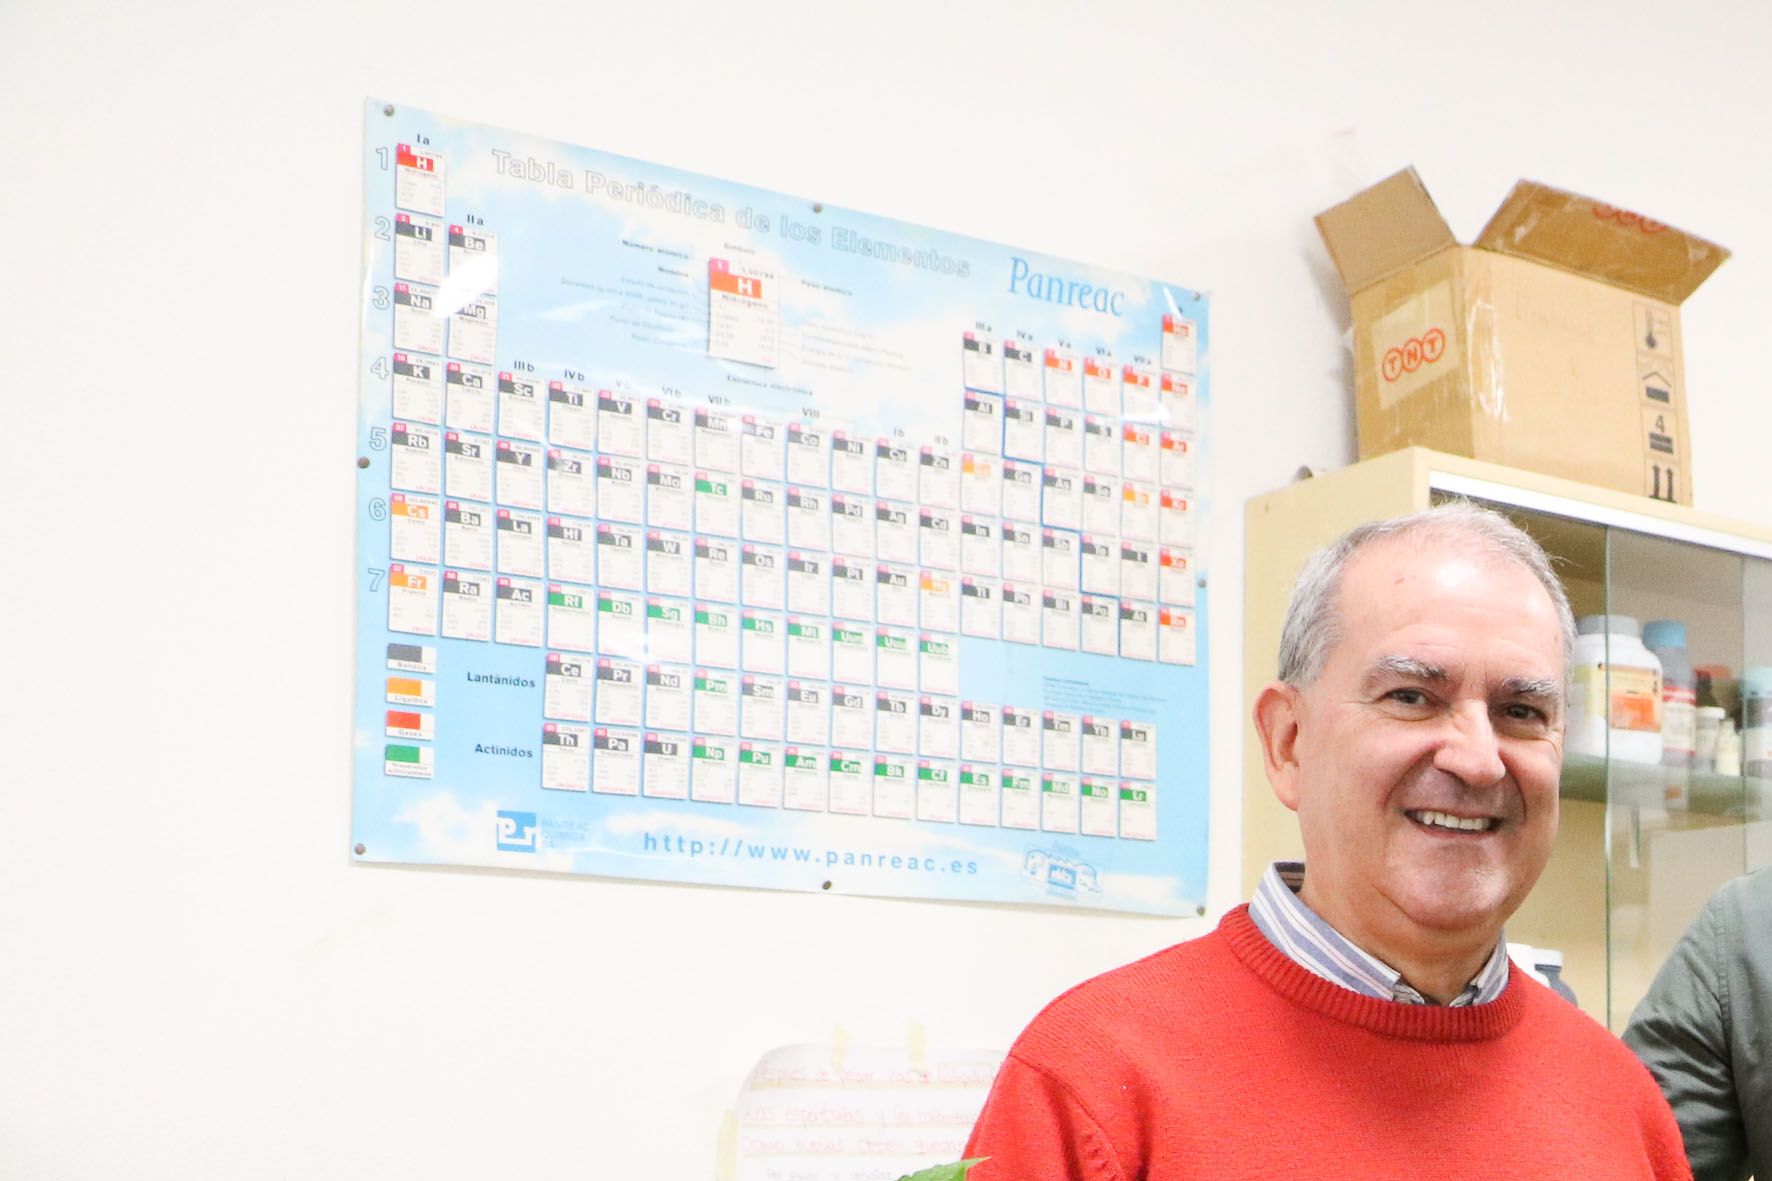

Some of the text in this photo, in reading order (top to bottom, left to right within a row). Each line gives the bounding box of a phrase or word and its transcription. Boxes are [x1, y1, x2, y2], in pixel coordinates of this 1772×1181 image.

[375, 147, 389, 171] 1
[416, 157, 427, 170] H
[491, 149, 971, 278] Tabla Periódica de los Elementos
[375, 216, 391, 241] 2
[414, 226, 427, 240] Li
[737, 277, 753, 294] H
[1008, 256, 1126, 317] Panreac
[372, 286, 390, 310] 3
[410, 295, 430, 310] Na
[1384, 329, 1445, 382] TNT
[371, 357, 389, 380] 4
[413, 366, 424, 378] K
[462, 374, 481, 388] Ca
[513, 383, 532, 397] Sc
[369, 427, 387, 451] 5
[407, 434, 428, 448] Rb
[461, 444, 479, 457] Sr
[515, 451, 526, 465] Y
[611, 465, 631, 481] Nb
[659, 475, 680, 488] Mo
[369, 497, 387, 521] 6
[407, 504, 427, 519] Cs
[460, 512, 480, 526] Ba
[512, 519, 531, 533] La
[662, 541, 678, 553] W
[368, 567, 386, 592] 7
[407, 577, 423, 589] Fr
[458, 582, 479, 595] Ra
[511, 588, 531, 602] Ac
[612, 601, 631, 614] Db
[560, 662, 580, 677] Ce
[612, 668, 629, 682] Pr
[659, 673, 679, 687] Nd
[558, 734, 575, 747] Th
[607, 739, 628, 751] Pa
[661, 743, 672, 754] U
[644, 832, 978, 876] http://www.panreac.es
